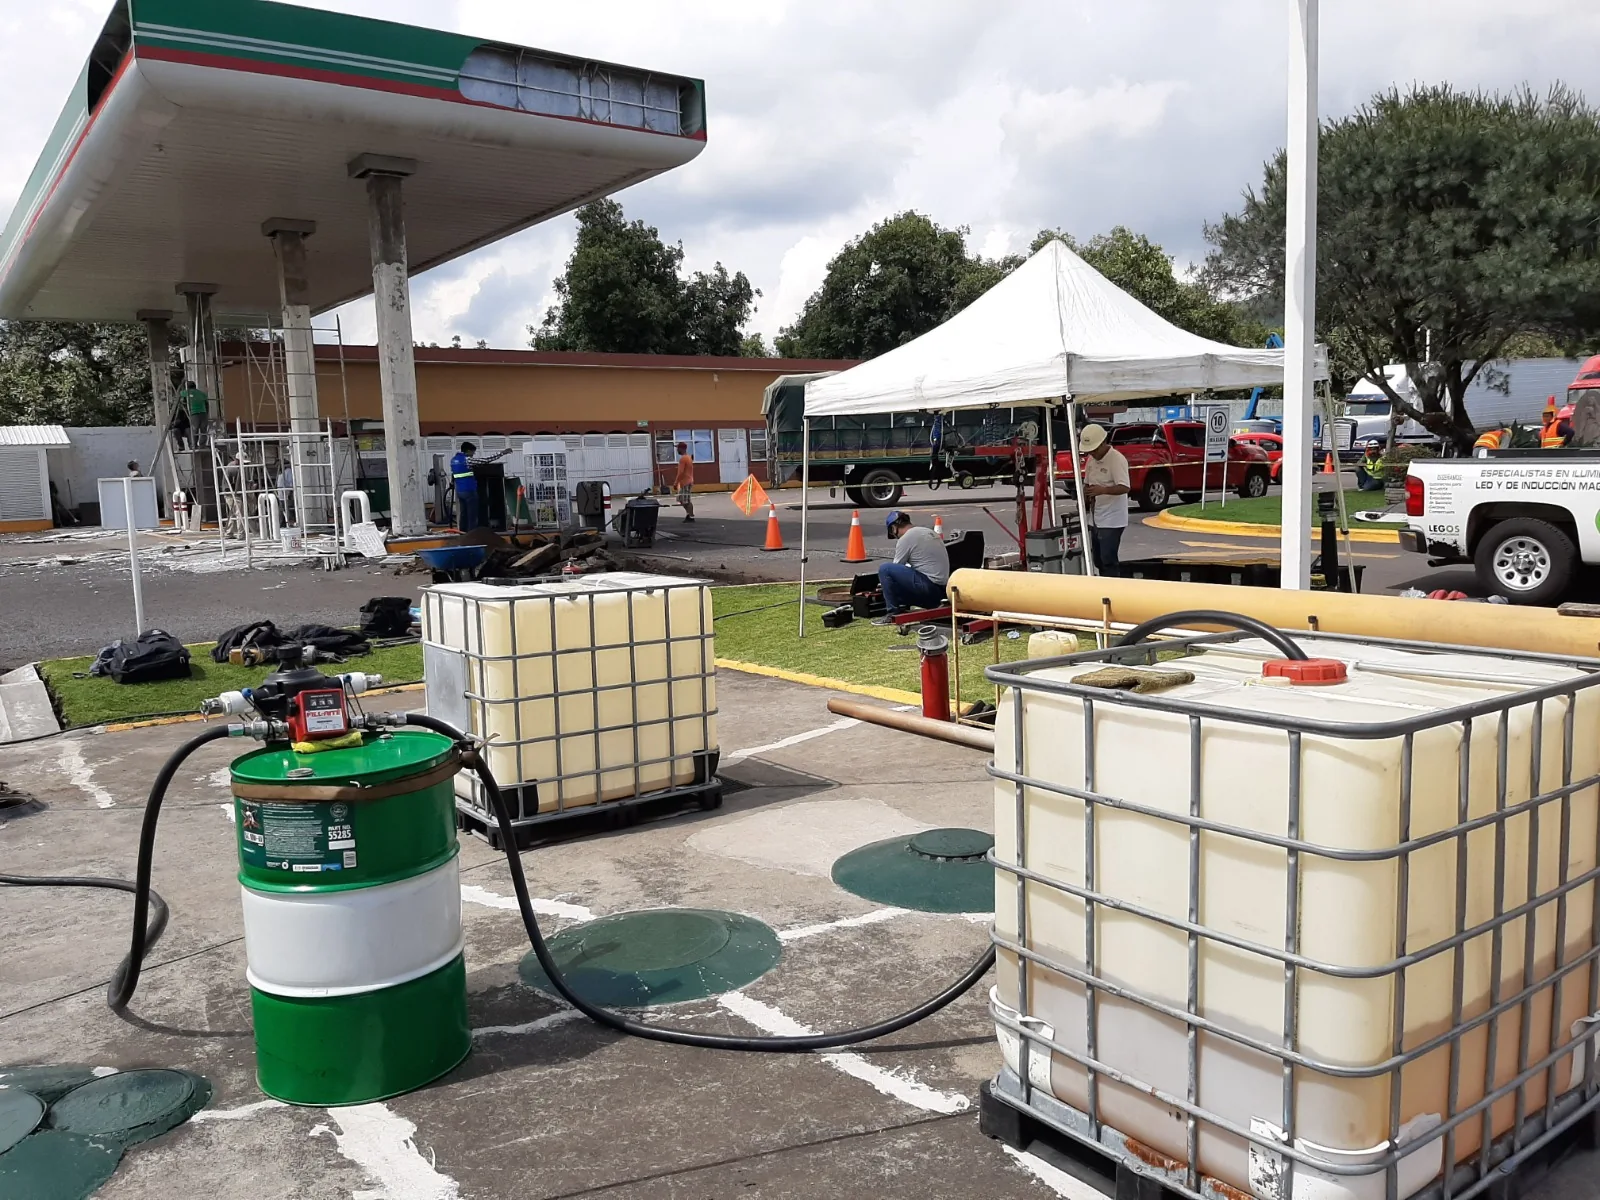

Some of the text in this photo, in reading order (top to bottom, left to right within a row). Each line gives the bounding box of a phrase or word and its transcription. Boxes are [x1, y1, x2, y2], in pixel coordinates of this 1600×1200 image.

[1213, 416, 1222, 426] 10
[1480, 469, 1600, 478] ESPECIALISTAS EN ILUMI
[1475, 481, 1494, 490] LED
[1496, 481, 1503, 490] Y
[1506, 481, 1519, 490] DE
[1521, 479, 1576, 490] INDUCCIÓN
[1428, 524, 1460, 533] LEGOS
[306, 709, 341, 718] FILL-RITE
[328, 830, 352, 840] 55285
